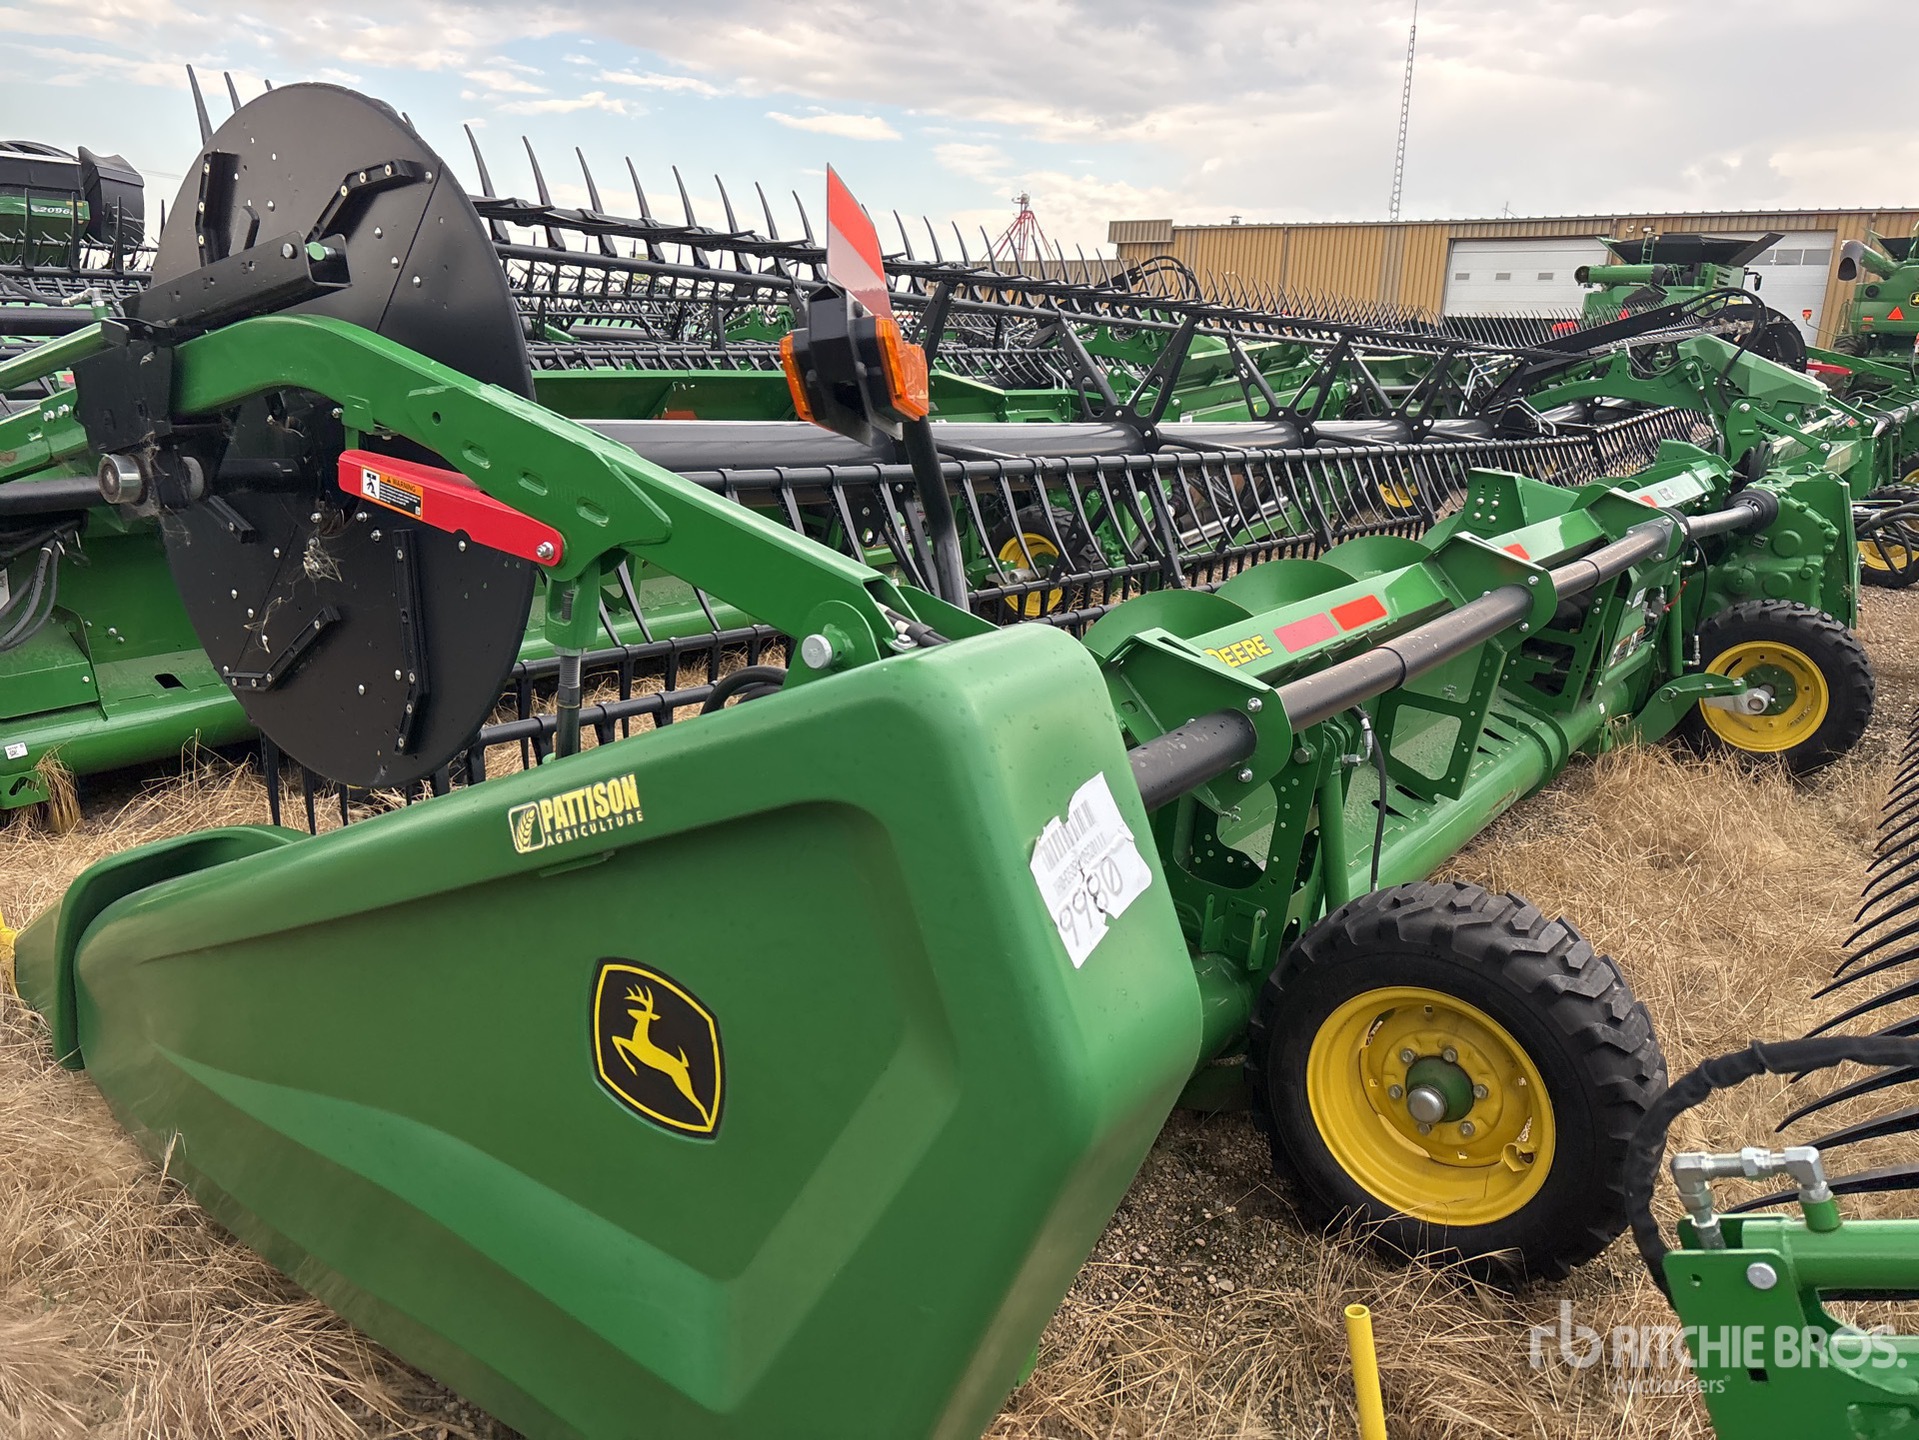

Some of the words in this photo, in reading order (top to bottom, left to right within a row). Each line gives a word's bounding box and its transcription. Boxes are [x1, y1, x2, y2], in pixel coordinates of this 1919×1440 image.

[393, 478, 417, 493] WARNING
[539, 773, 640, 833] PATTISON
[546, 810, 644, 847] AGRICULTURE
